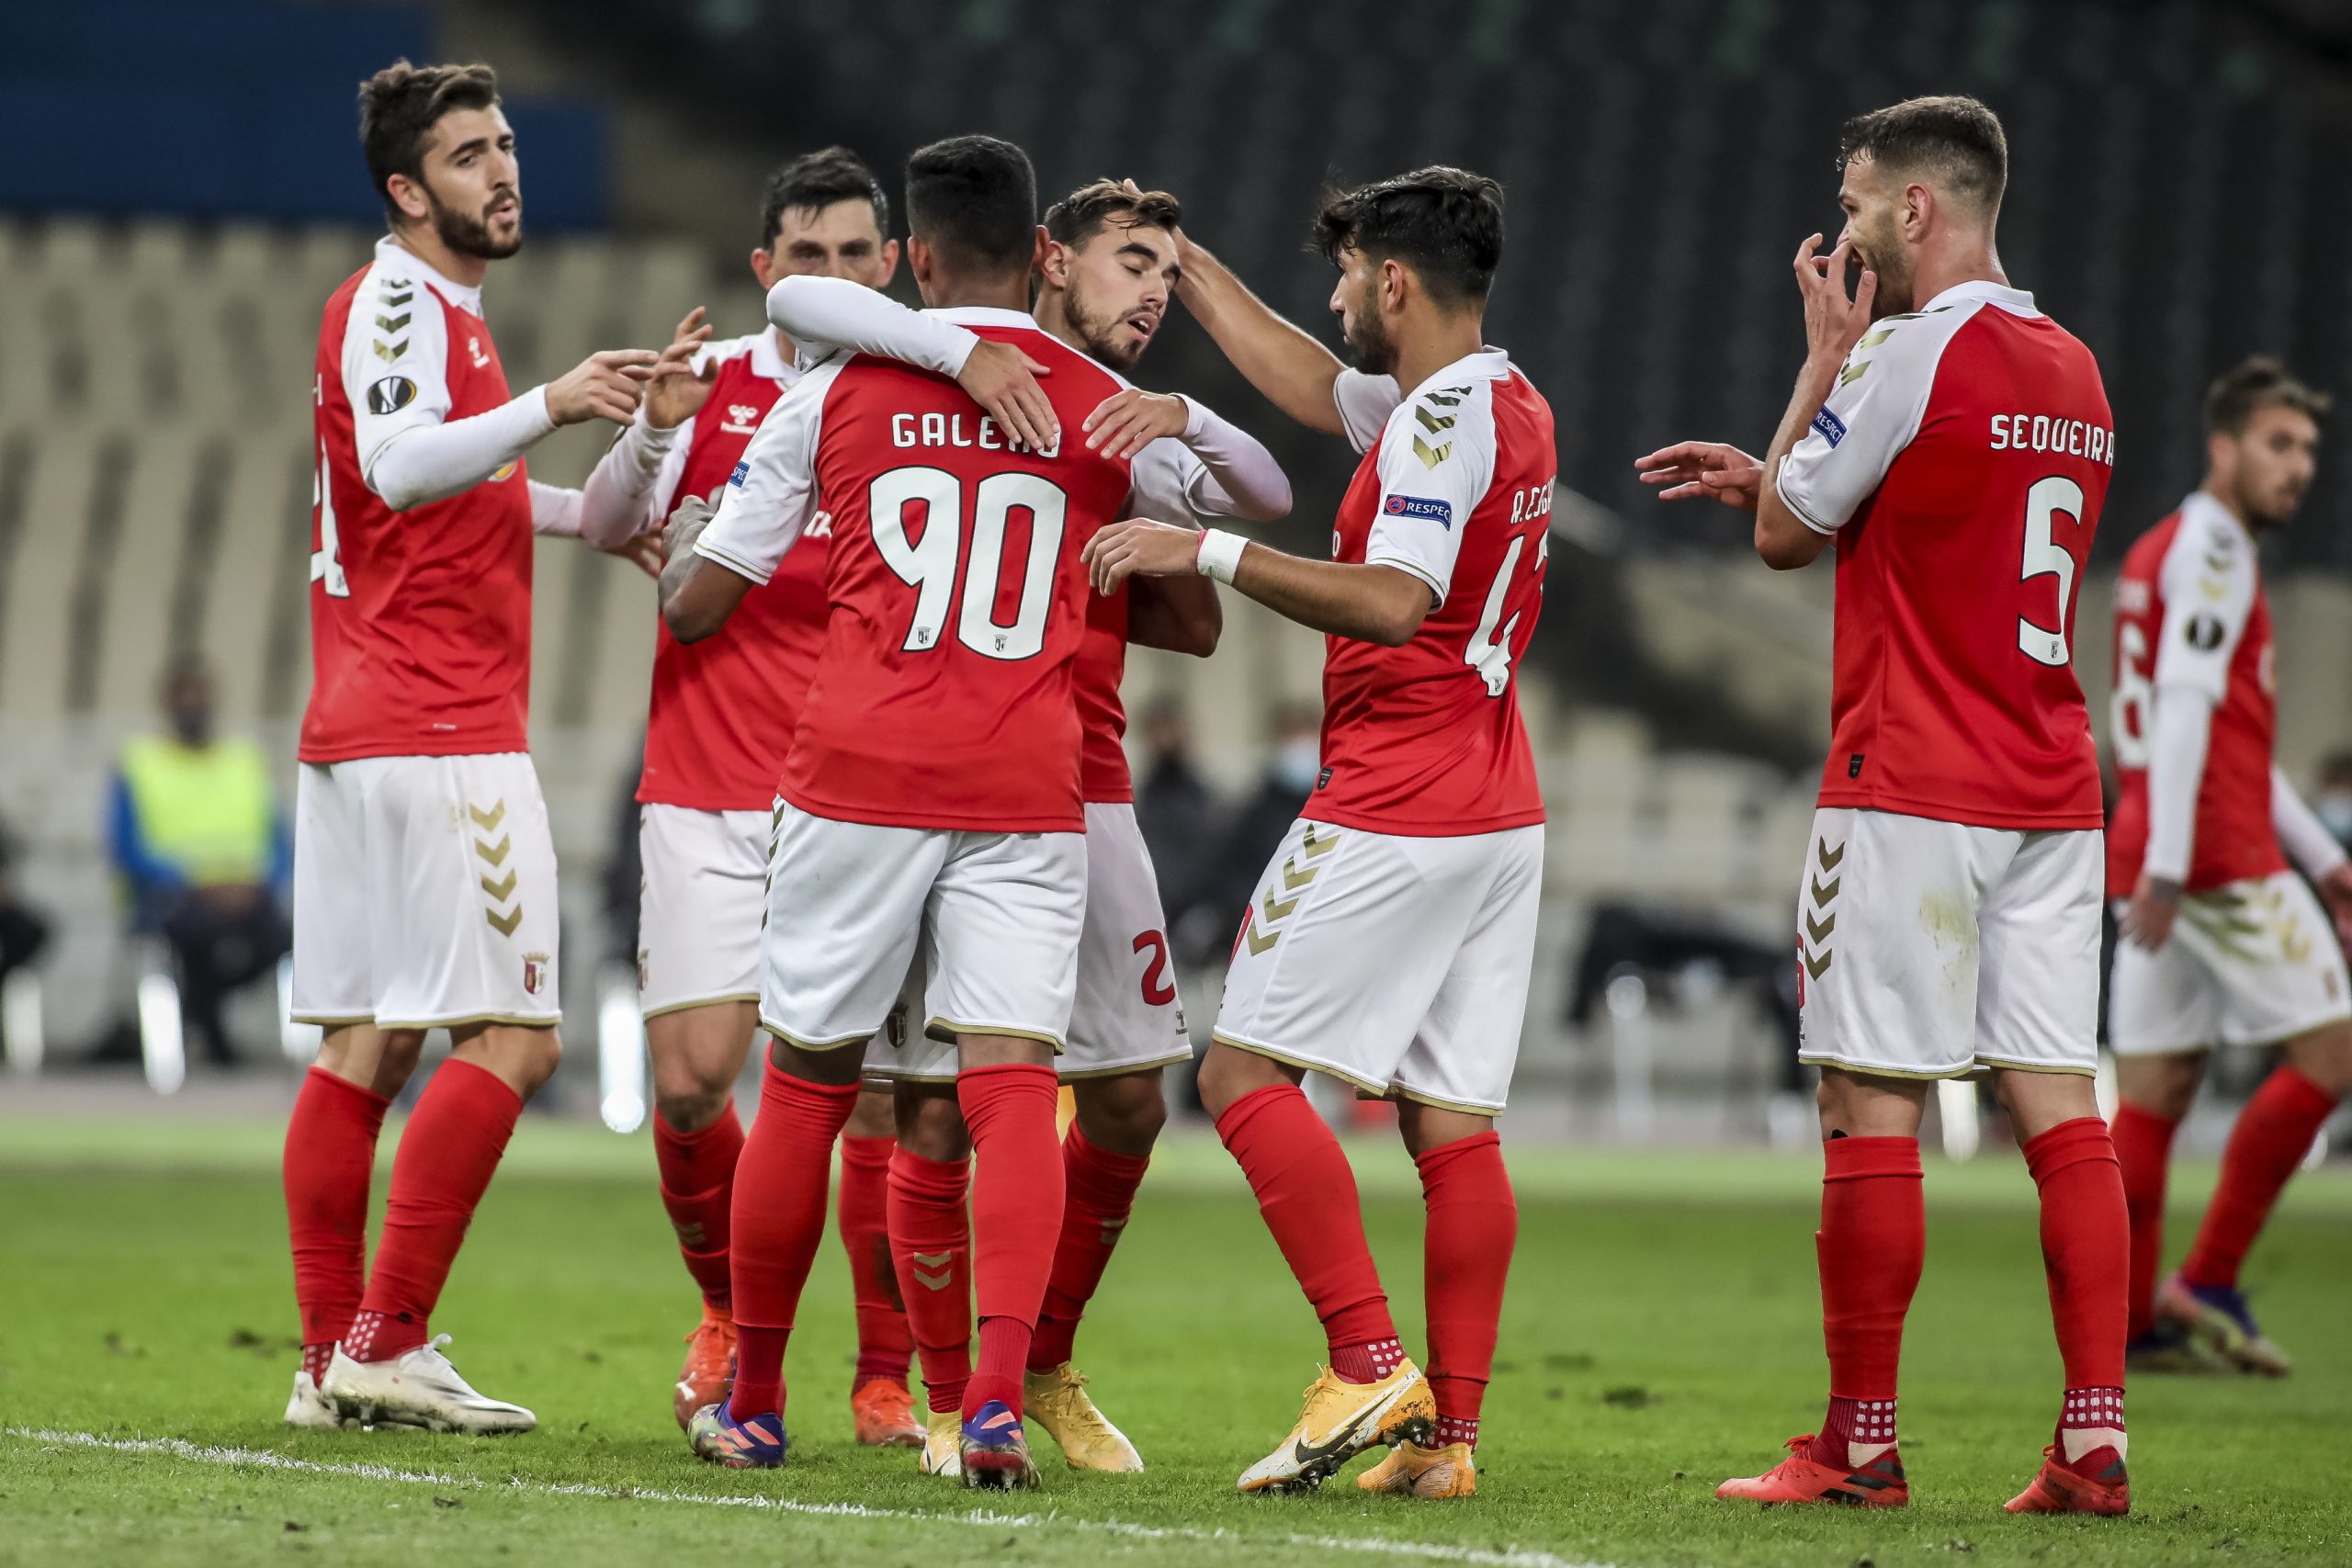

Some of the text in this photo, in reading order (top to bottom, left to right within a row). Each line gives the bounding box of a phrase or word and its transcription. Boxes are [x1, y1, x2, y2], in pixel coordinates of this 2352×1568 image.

[892, 412, 1062, 458] GALEO
[1815, 412, 1843, 442] RESPECT
[1990, 413, 2113, 467] SEQUEIRA
[868, 465, 1068, 660] 90
[2018, 474, 2084, 668] 5
